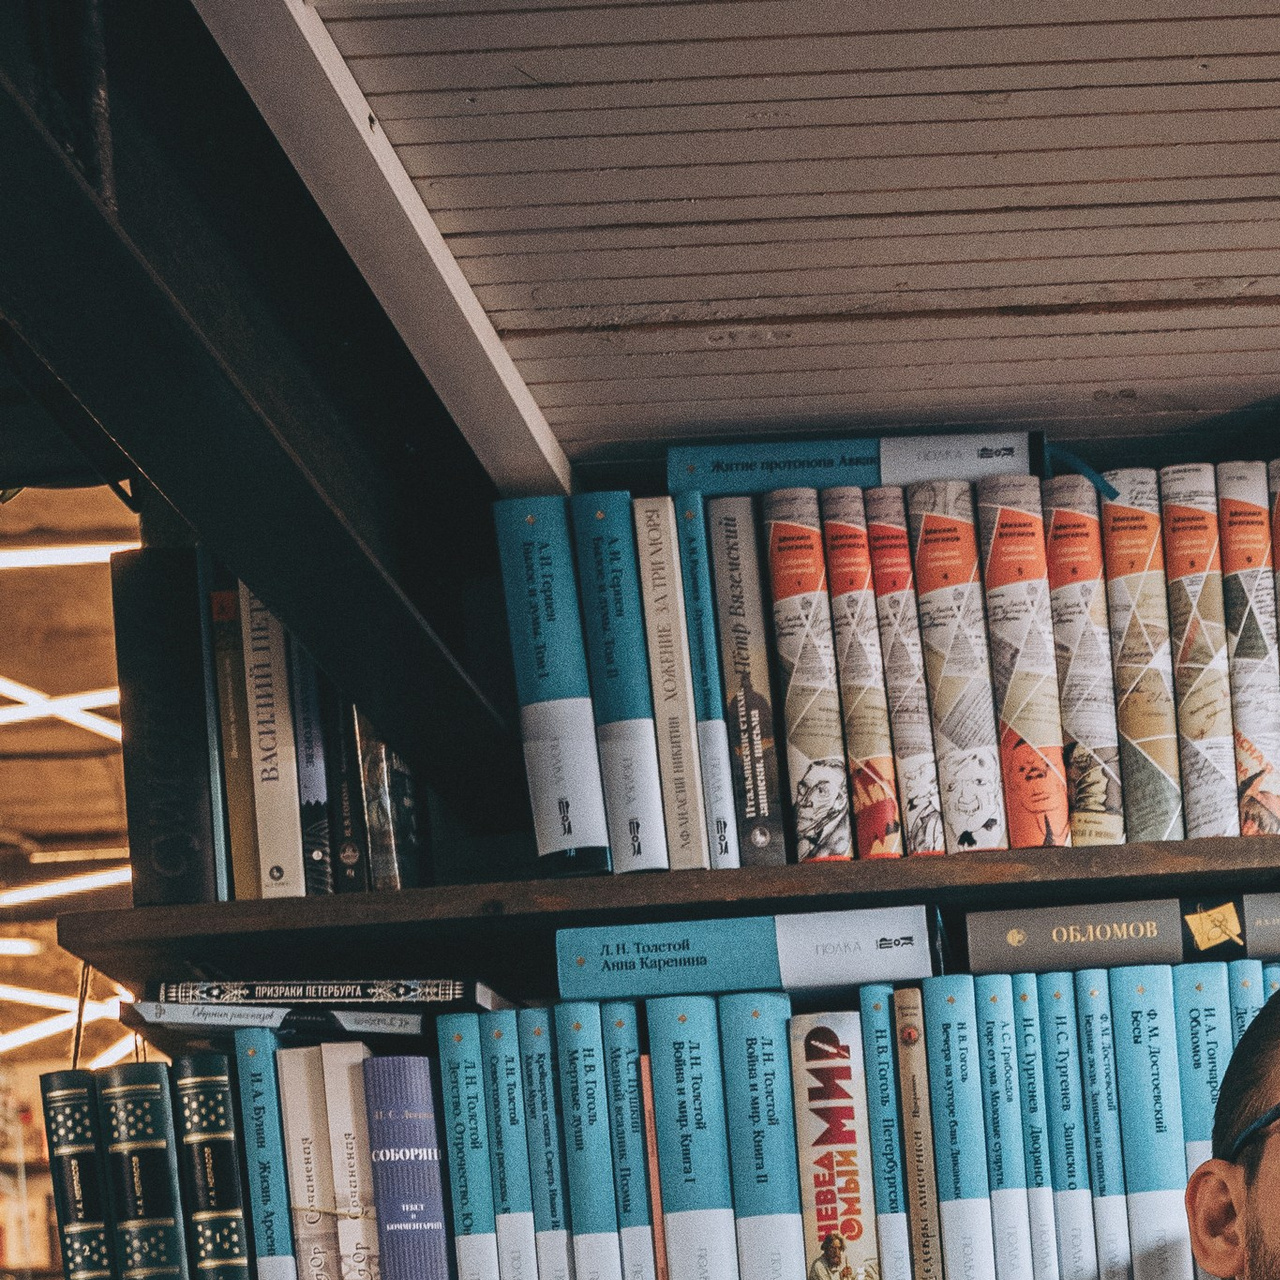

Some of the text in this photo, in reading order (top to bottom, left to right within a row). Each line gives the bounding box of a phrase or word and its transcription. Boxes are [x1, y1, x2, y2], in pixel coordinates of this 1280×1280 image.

[250, 665, 280, 783] ВАСИЛИЙ
[1050, 920, 1158, 945] ОБЛОМОВ
[634, 939, 690, 953] Толстой
[601, 955, 708, 972] Анна Каренина
[255, 983, 362, 999] ПРИЗРАКИ ПЕТЕРБУРГА
[1131, 1010, 1142, 1045] Бесы
[1148, 1043, 1168, 1134] Достоевский
